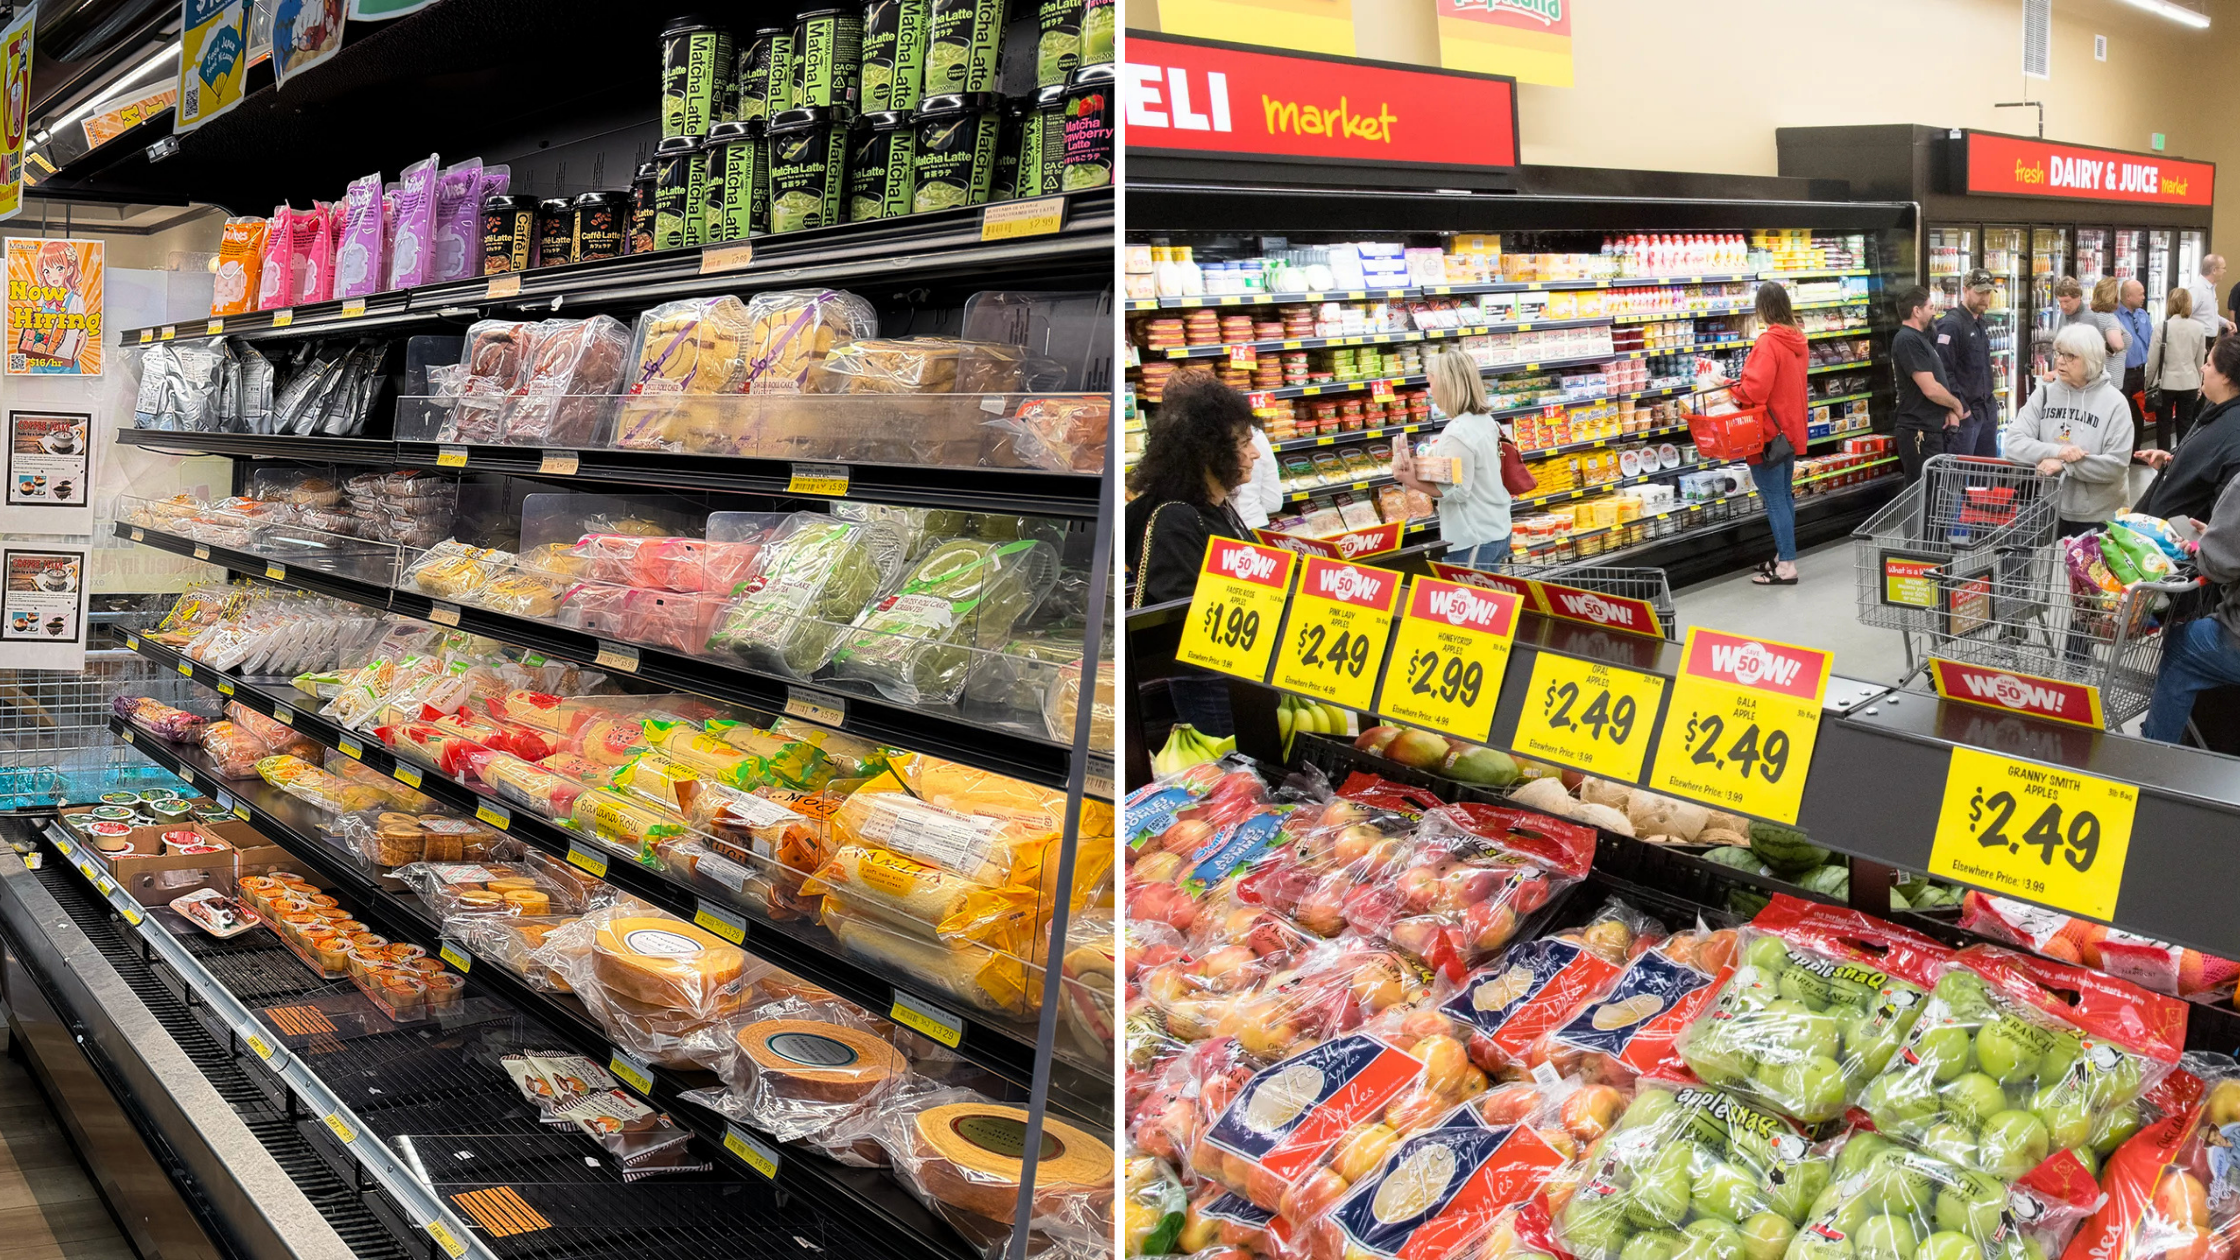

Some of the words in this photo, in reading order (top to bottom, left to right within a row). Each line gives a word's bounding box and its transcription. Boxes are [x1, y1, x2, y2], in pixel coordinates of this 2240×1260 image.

[945, 9, 973, 21] Latte
[975, 0, 996, 42] tcha
[824, 20, 833, 56] MORIYAMA
[872, 32, 896, 44] Latte
[897, 0, 920, 63] Matcha
[807, 21, 826, 83] Matcha
[668, 66, 687, 77] Latte
[688, 36, 709, 97] Matcha
[770, 39, 790, 97] Matcha
[969, 45, 992, 91] Latte
[893, 65, 915, 109] Latte
[1125, 62, 1232, 132] ELI
[1261, 93, 1398, 143] market
[686, 96, 705, 135] Latte
[1065, 117, 1101, 133] Matcha
[1063, 128, 1114, 143] rawberry
[973, 120, 997, 186] Matcha
[1067, 140, 1092, 151] Latte
[826, 133, 844, 195] Matcha
[944, 151, 972, 162] Latte
[800, 162, 826, 173] Latte
[861, 167, 886, 178] Latte
[887, 135, 911, 199] Matcha
[1043, 162, 1056, 170] CA
[727, 146, 745, 205] Matcha
[2015, 157, 2044, 184] fresh
[2050, 155, 2104, 190] DAIRY
[2105, 161, 2117, 191] &
[2119, 163, 2159, 194] JUICE
[2161, 176, 2189, 197] market
[665, 186, 686, 196] Latte
[688, 158, 706, 215] Matcha
[1029, 217, 1054, 229] $2.99
[497, 233, 513, 243] Latte
[551, 236, 572, 245] Latte
[601, 230, 621, 240] Latte
[9, 243, 39, 251] Mitsuwa
[9, 280, 68, 302] Now
[13, 307, 102, 337] Hiring
[29, 358, 64, 368] $16/hr
[17, 419, 48, 431] COFFEE
[49, 421, 71, 432] JELLY
[2040, 407, 2100, 429] DISNEYLAND
[12, 558, 41, 569] COFFEE
[1887, 565, 1905, 575] What
[1906, 566, 1913, 575] is
[1226, 585, 1243, 597] PACIFIC
[1229, 596, 1247, 607] APPLES
[1328, 606, 1341, 618] PINK
[1341, 609, 1356, 620] LADY
[1203, 602, 1260, 651] $1.99
[1330, 617, 1350, 629] APPLES
[1437, 631, 1473, 646] HONEYCRISP
[1187, 650, 1205, 663] Elsewhere
[1205, 655, 1221, 666] Price:
[1297, 621, 1370, 678] $2.49
[1442, 643, 1464, 656] APPLES
[1591, 664, 1609, 677] OPAL
[1711, 643, 1802, 687] WOW!
[1285, 675, 1308, 689] Elsewhere
[1308, 680, 1322, 692] Price:
[1407, 648, 1484, 708] $2.99
[1585, 675, 1610, 688] APPLES
[1652, 677, 1662, 687] Bag
[1962, 673, 2066, 713] WOW!
[1736, 696, 1757, 709] GALA
[820, 711, 839, 722] $5.99
[1391, 703, 1417, 719] Elsewhere
[1417, 710, 1434, 723] Price:
[1543, 678, 1637, 745] $2.49
[1732, 708, 1756, 721] APPLE
[1806, 710, 1817, 721] Bag
[1528, 738, 1557, 755] Elsewhere
[1557, 745, 1576, 760] Price:
[1684, 711, 1790, 784] $2.49
[1669, 774, 1702, 794] Elsewhere
[1703, 784, 1724, 799] Price:
[2007, 765, 2048, 786] GRANNY
[2049, 774, 2081, 792] SMITH
[2024, 783, 2059, 801] APPLES
[2107, 786, 2118, 797] 3lb
[2119, 789, 2134, 802] Bag
[579, 799, 619, 825] Banana
[618, 814, 640, 833] Roll
[1968, 786, 2101, 873] $2.49
[1214, 826, 1256, 868] APPLES
[1216, 828, 1266, 871] POMMES
[854, 846, 942, 886] VANILLA
[1952, 858, 1994, 881] Elsewhere
[1995, 870, 2020, 888] Price:
[865, 868, 877, 877] soft
[891, 873, 905, 883] with
[724, 927, 740, 940] $3.29
[931, 1023, 955, 1040] $3.29
[2010, 1020, 2055, 1053] RANCH
[634, 1076, 649, 1089] $6.99
[1320, 1083, 1375, 1139] Apples
[754, 1156, 773, 1173] $6.99
[1475, 1166, 1514, 1226] pples
